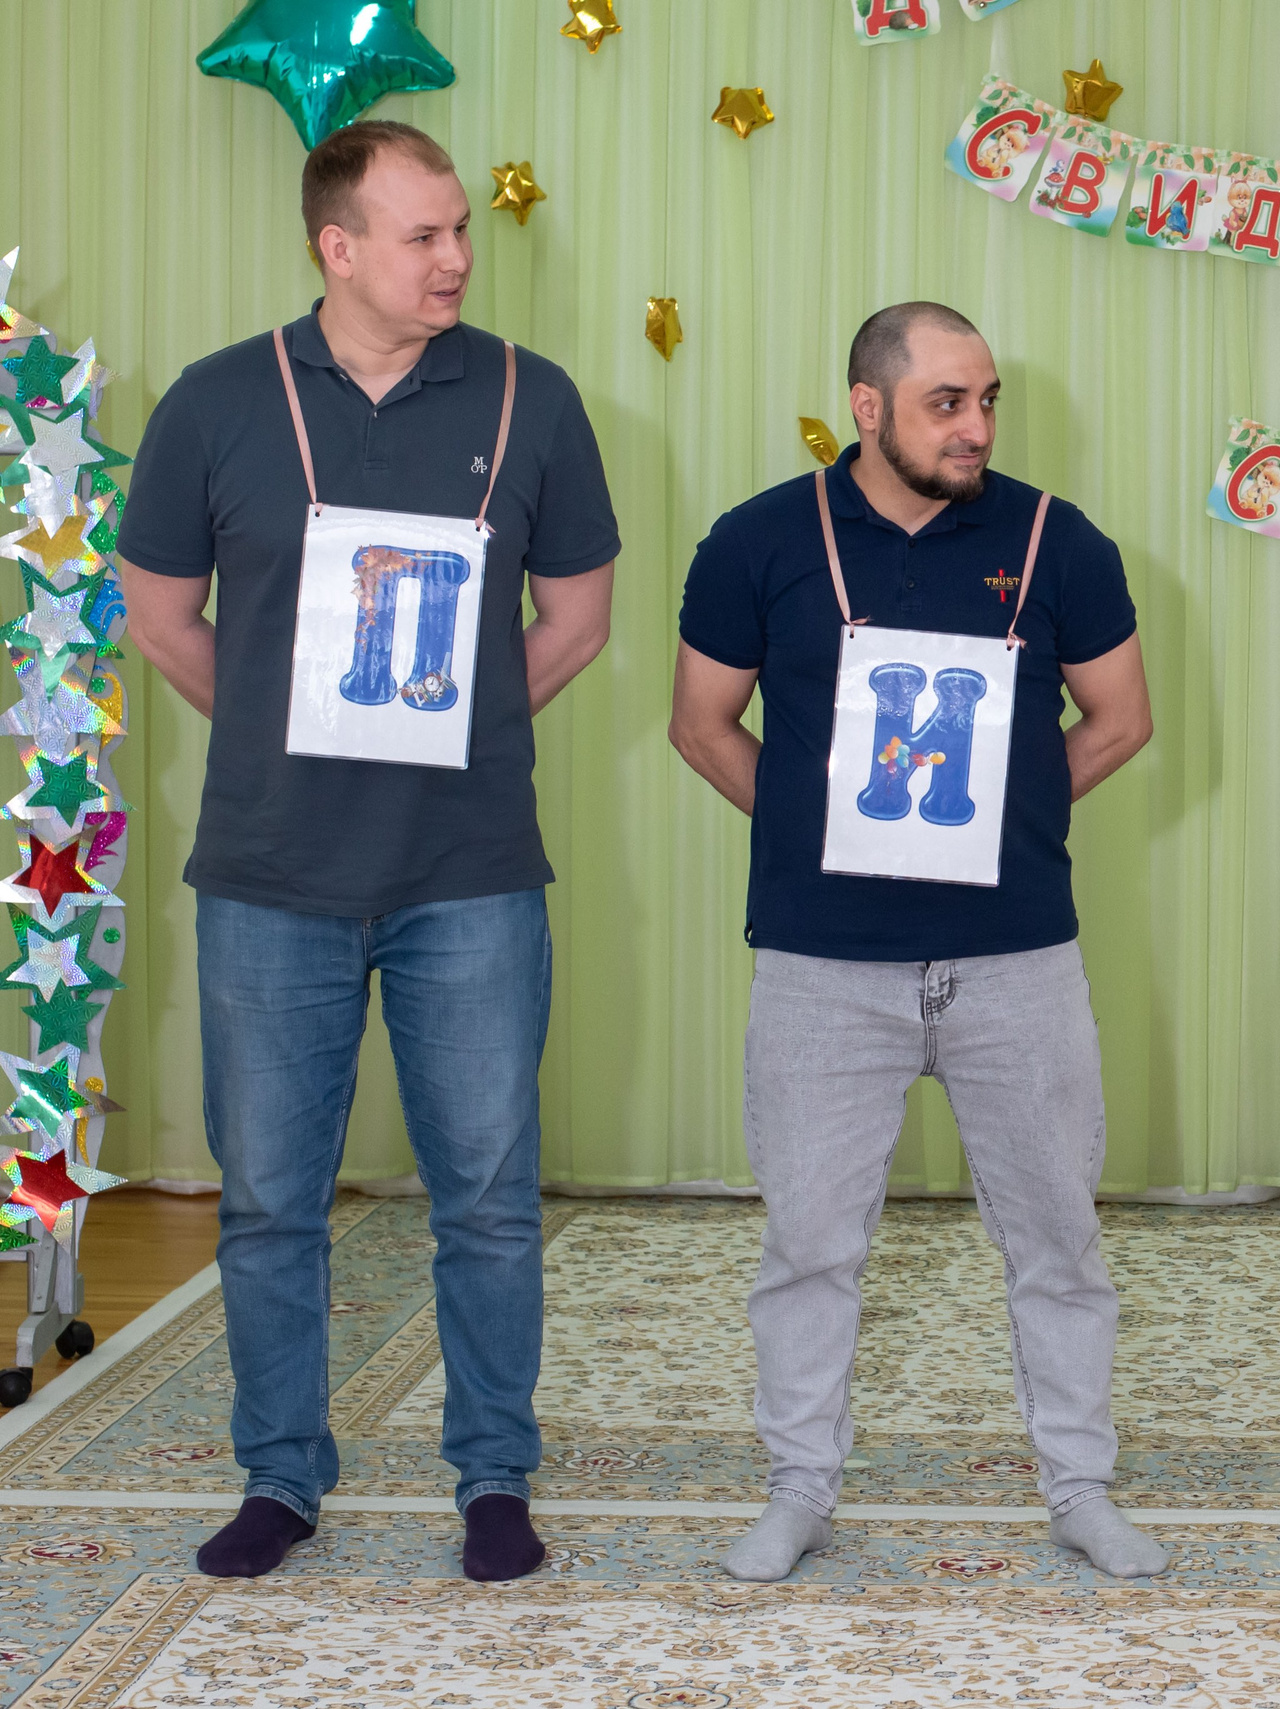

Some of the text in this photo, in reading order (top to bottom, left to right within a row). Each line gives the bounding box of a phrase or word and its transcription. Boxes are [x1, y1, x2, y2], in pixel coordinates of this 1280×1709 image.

[339, 545, 470, 711] П
[984, 577, 1020, 586] TRUST
[857, 662, 987, 826] И
